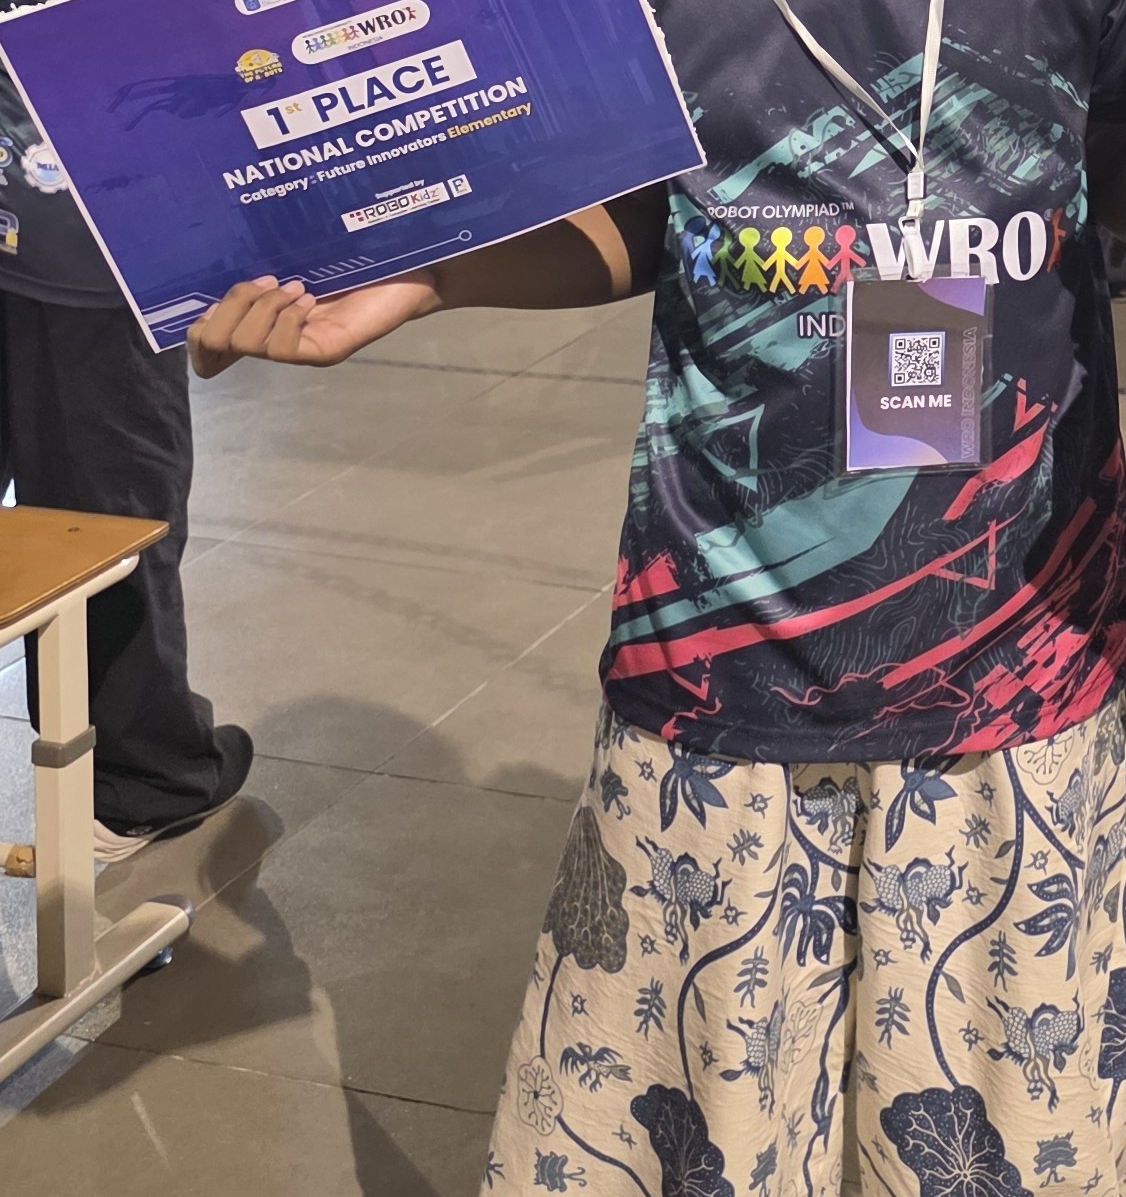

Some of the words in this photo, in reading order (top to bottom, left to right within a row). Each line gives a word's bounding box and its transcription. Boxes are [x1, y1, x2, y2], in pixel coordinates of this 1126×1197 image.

[357, 9, 406, 36] WRO
[267, 101, 303, 135] 1st
[312, 55, 450, 122] PLACE
[223, 137, 354, 189] NATIONAL
[355, 76, 528, 147] COMPETITION
[317, 159, 366, 182] Future
[367, 131, 447, 166] Innovators
[447, 102, 532, 138] Elementary
[762, 203, 839, 219] OLYMPIAD
[866, 210, 1047, 284] WRO
[880, 395, 925, 410] SCAN
[928, 394, 952, 408] ME
[961, 326, 978, 416] INDONESIA
[961, 418, 975, 459] WRO
